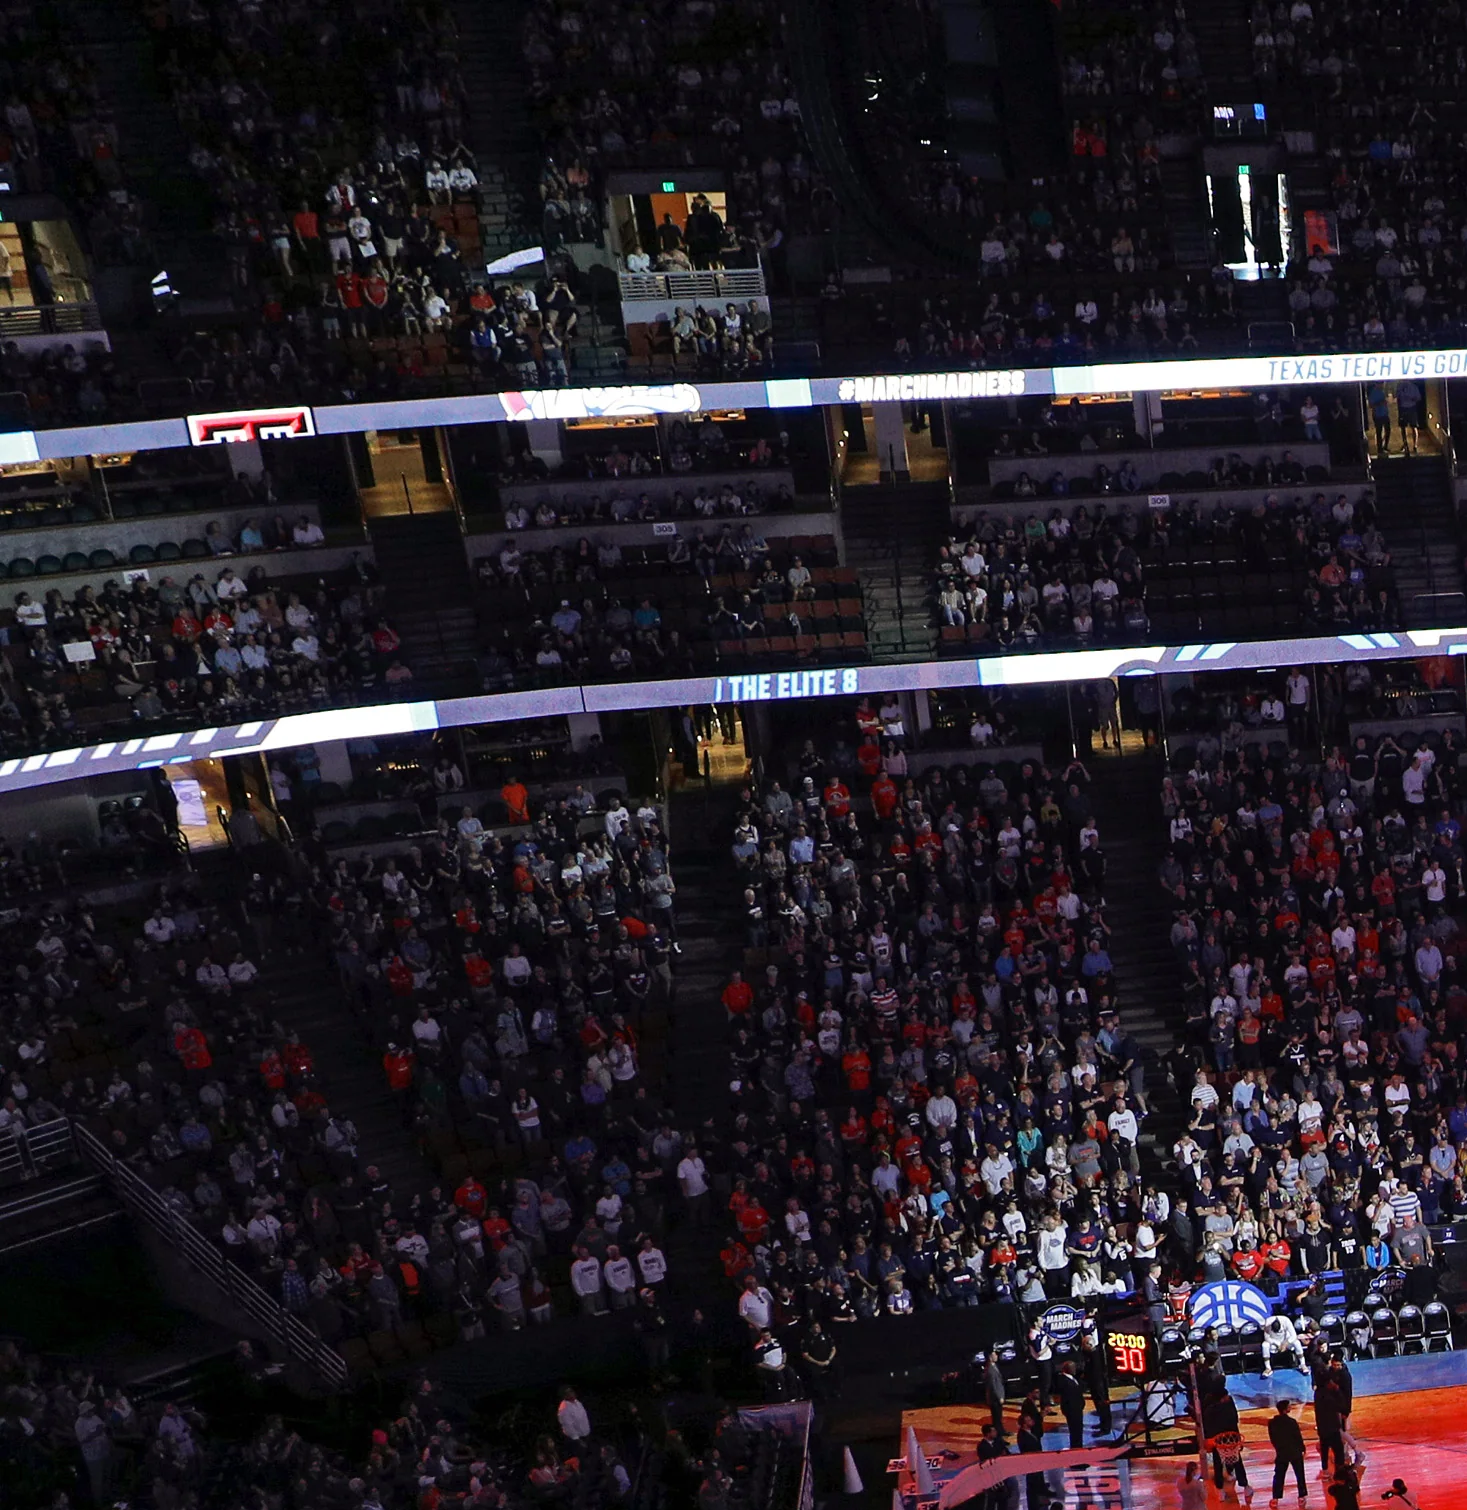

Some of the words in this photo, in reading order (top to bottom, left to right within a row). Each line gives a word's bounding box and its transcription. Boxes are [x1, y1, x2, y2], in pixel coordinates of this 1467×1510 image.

[1269, 358, 1333, 381] TEXAS
[1342, 356, 1392, 378] TECH
[1401, 354, 1426, 376] VS
[838, 371, 1025, 402] #MARCHMADNESS
[728, 674, 771, 702] THE
[777, 669, 837, 698] ELITE
[842, 668, 858, 694] 8
[1046, 1312, 1074, 1325] MARCH
[1050, 1319, 1082, 1332] MADNES
[1108, 1332, 1146, 1350] 20:00
[1113, 1347, 1146, 1374] 30
